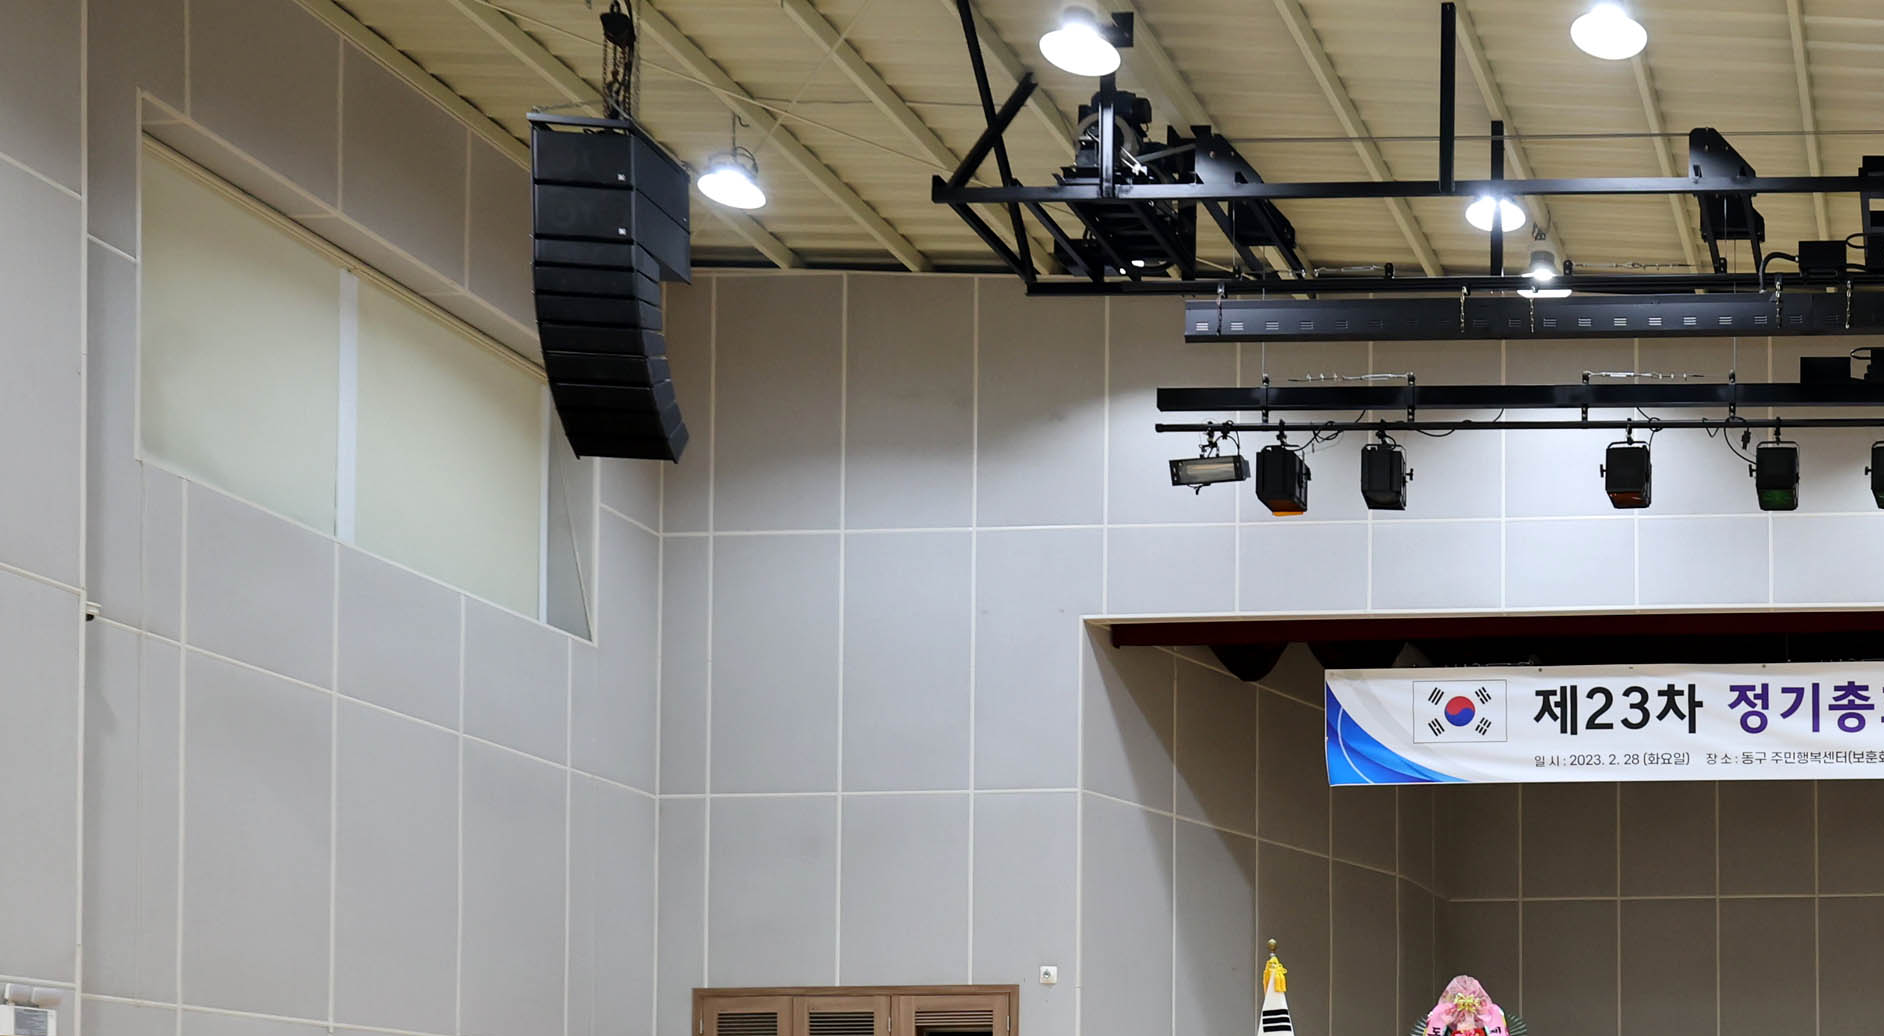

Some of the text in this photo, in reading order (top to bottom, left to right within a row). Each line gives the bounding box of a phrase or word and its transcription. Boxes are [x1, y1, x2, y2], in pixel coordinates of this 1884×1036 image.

[1533, 683, 1703, 736] 제23차
[1568, 753, 1605, 766] 2023.
[1623, 753, 1640, 766] 28
[1642, 751, 1690, 766] (화요일)
[1740, 751, 1767, 764] 동구
